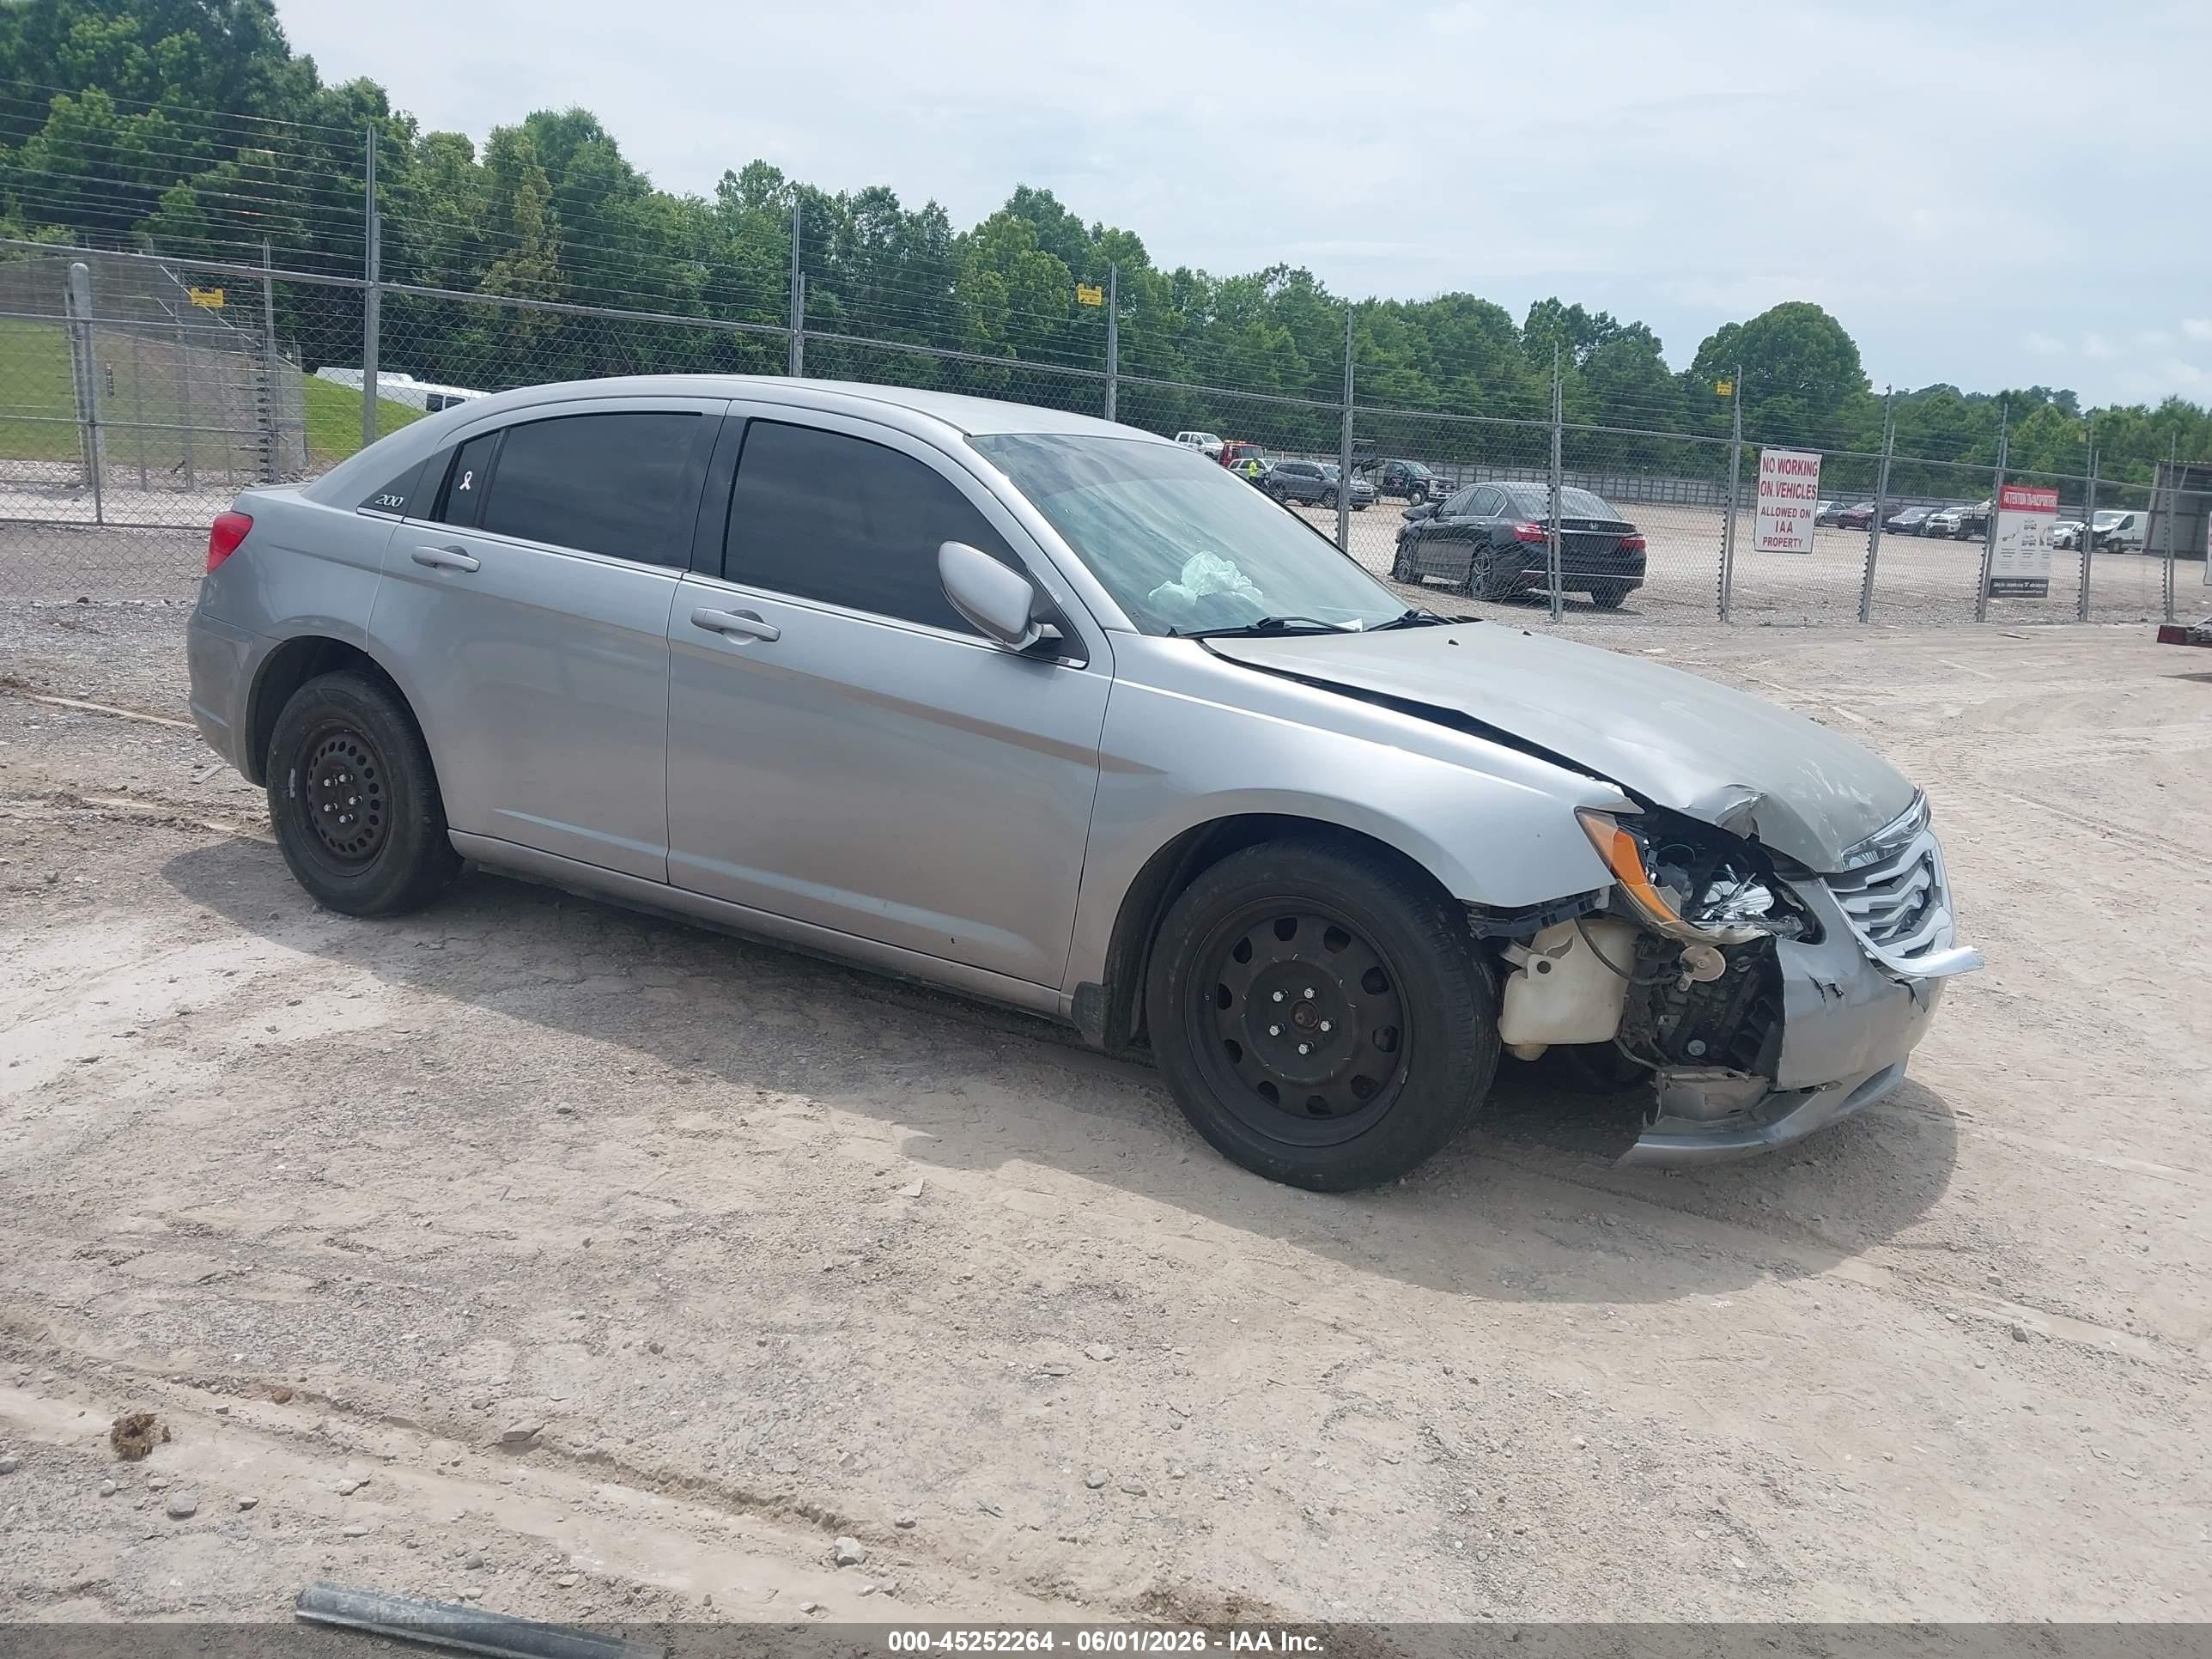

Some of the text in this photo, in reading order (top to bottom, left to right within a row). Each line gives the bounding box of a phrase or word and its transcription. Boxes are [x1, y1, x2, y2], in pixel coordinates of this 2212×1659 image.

[1762, 457, 1818, 477] NO WORKING
[1760, 481, 1817, 500] ON VEHICLES
[374, 494, 404, 507] 200
[1760, 506, 1811, 519] ALLOWED ON
[1775, 520, 1793, 533] IAA
[1762, 537, 1803, 549] PROPERTY
